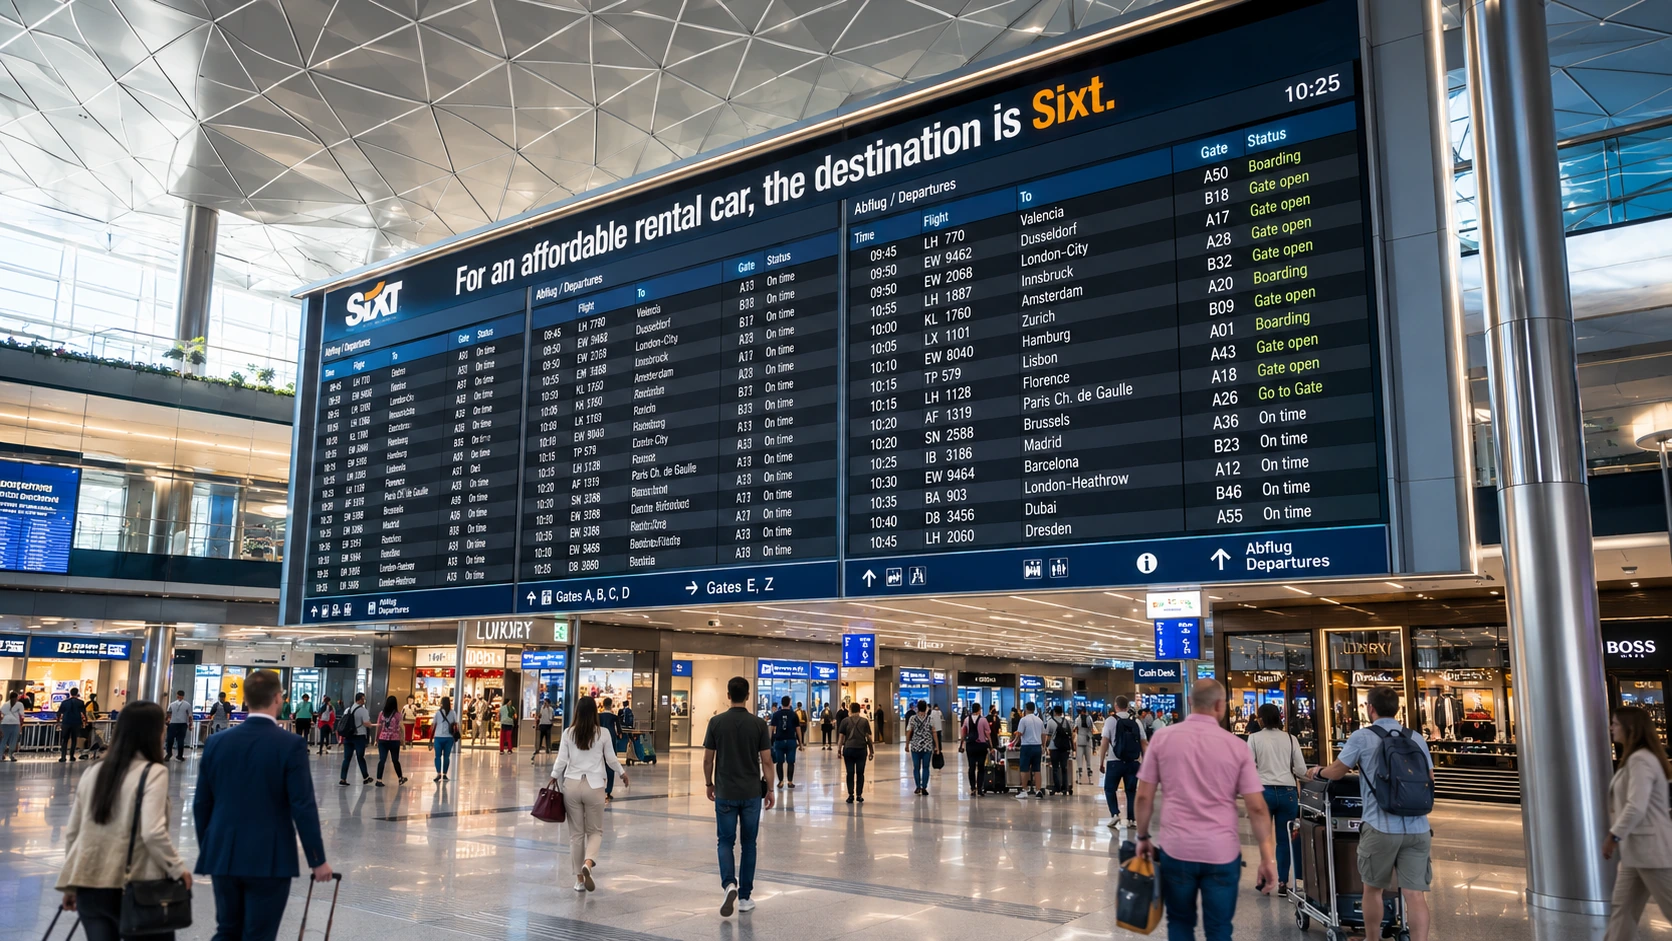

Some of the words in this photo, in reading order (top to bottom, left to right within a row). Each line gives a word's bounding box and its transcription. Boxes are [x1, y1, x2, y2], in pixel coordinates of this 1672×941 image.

[1285, 73, 1340, 102] 10:25
[455, 264, 486, 296] For
[490, 258, 515, 285] an
[520, 220, 627, 277] affordable
[634, 193, 702, 244] rental
[710, 186, 754, 222] car,
[762, 170, 805, 206] the
[814, 119, 981, 192] destination
[993, 103, 1021, 141] is
[1032, 75, 1115, 129] Sixt.
[854, 231, 875, 243] Time
[923, 211, 949, 227] Flight
[1019, 190, 1032, 203] To
[1200, 143, 1228, 159] Gate
[1247, 129, 1287, 147] Status
[854, 198, 887, 215] Abflug
[898, 179, 956, 203] Departures
[870, 245, 897, 262] 09:45
[924, 235, 938, 249] LH
[945, 229, 965, 244] 770
[1020, 206, 1064, 226] Valencia
[1203, 165, 1228, 184] A50
[1248, 151, 1301, 172] Boarding
[870, 263, 897, 280] 09:50
[924, 253, 941, 268] EW
[945, 246, 972, 264] 9462
[1020, 221, 1077, 247] Dusseldorf
[1205, 187, 1229, 205] B18
[1249, 179, 1276, 194] Gate
[1279, 172, 1309, 189] open
[870, 282, 897, 299] 09:50
[924, 273, 941, 288] EW
[945, 266, 973, 283] 2068
[1021, 242, 1088, 267] London-City
[1205, 209, 1229, 227] A17
[1250, 201, 1277, 217] Gate
[1280, 195, 1310, 211] open
[563, 274, 603, 293] Departures
[637, 288, 646, 298] To
[738, 261, 755, 273] Gate
[766, 252, 791, 266] Status
[766, 275, 777, 286] On
[779, 272, 795, 284] time
[870, 301, 897, 317] 10:55
[924, 292, 938, 307] LH
[946, 286, 972, 302] 1887
[1021, 265, 1073, 287] Innsbruck
[1206, 231, 1231, 249] A28
[1251, 224, 1278, 239] Gate
[1281, 217, 1311, 235] open
[871, 320, 897, 336] 10:00
[924, 313, 938, 326] KL
[946, 306, 971, 322] 1760
[1021, 286, 1083, 307] Amsterdam
[1207, 254, 1232, 271] B32
[1252, 247, 1280, 261] Gate
[1283, 240, 1313, 257] open
[345, 280, 403, 327] SIXT
[870, 339, 897, 355] 10:05
[924, 331, 938, 346] LX
[946, 326, 969, 341] 1101
[1022, 309, 1055, 327] Zurich
[1207, 276, 1233, 293] A20
[1253, 265, 1308, 284] Boarding
[870, 358, 897, 374] 10:10
[924, 350, 942, 365] EW
[946, 345, 974, 361] 8040
[1022, 330, 1070, 347] Hamburg
[1209, 298, 1234, 316] B09
[1254, 292, 1281, 307] Gate
[1285, 287, 1316, 304] open
[870, 377, 897, 393] 10:15
[924, 371, 938, 384] TP
[941, 367, 961, 382] 579
[1022, 353, 1058, 368] Lisbon
[1209, 321, 1234, 339] A01
[1255, 311, 1310, 330] Boarding
[870, 397, 897, 412] 10:15
[925, 390, 939, 404] LH
[945, 385, 971, 400] 1128
[1023, 373, 1070, 389] Florence
[1210, 344, 1236, 361] A43
[1256, 339, 1284, 354] Gate
[1288, 335, 1318, 351] open
[870, 416, 897, 431] 10:20
[924, 410, 939, 424] AF
[946, 406, 972, 420] 1319
[1023, 395, 1050, 410] Paris
[1054, 391, 1073, 405] Ch.
[1077, 388, 1092, 402] de
[1096, 382, 1133, 399] Gaulle
[1211, 367, 1237, 384] A18
[1257, 362, 1285, 377] Gate
[1289, 358, 1320, 374] open
[764, 399, 776, 410] On
[777, 397, 794, 409] time
[870, 436, 897, 450] 10:20
[925, 430, 940, 444] SN
[946, 426, 974, 441] 2588
[1024, 413, 1070, 431] Brussels
[1212, 390, 1238, 407] A26
[1258, 386, 1275, 400] Go
[1278, 385, 1291, 397] to
[1294, 381, 1323, 395] Gate
[870, 455, 897, 470] 10:25
[925, 450, 936, 464] IB
[946, 446, 972, 461] 3186
[1024, 434, 1062, 452] Madrid
[1213, 413, 1239, 430] A36
[1259, 410, 1276, 424] On
[1279, 408, 1306, 422] time
[870, 475, 897, 489] 10:30
[925, 470, 943, 484] EW
[946, 466, 975, 481] 9464
[1024, 456, 1079, 473] Barcelona
[1214, 437, 1240, 453] B23
[1260, 434, 1277, 448] On
[1280, 432, 1308, 446] time
[870, 495, 897, 509] 10:35
[925, 491, 941, 504] BA
[946, 488, 967, 502] 903
[1024, 473, 1129, 494] London-Heathrow
[1215, 460, 1240, 476] A12
[1261, 457, 1278, 471] On
[1281, 456, 1309, 470] time
[870, 515, 897, 529] 10:40
[925, 511, 940, 524] D8
[947, 508, 974, 523] 3456
[1025, 500, 1057, 516] Dubai
[1216, 484, 1242, 500] B46
[1262, 482, 1279, 496] On
[1282, 480, 1310, 494] time
[762, 545, 774, 556] On
[775, 544, 792, 555] time
[870, 534, 897, 548] 10:45
[925, 531, 940, 545] LH
[947, 529, 974, 543] 2060
[1025, 521, 1072, 537] Dresden
[1216, 508, 1243, 524] A55
[1263, 506, 1280, 520] On
[1284, 505, 1311, 519] time
[1246, 541, 1293, 556] Abflug
[706, 580, 742, 595] Gates
[747, 578, 759, 594] E,
[764, 576, 774, 591] Z
[1246, 555, 1330, 572] Departures
[556, 590, 583, 603] Gates
[584, 589, 595, 603] A,
[596, 588, 607, 602] B,
[608, 586, 619, 601] C,
[622, 586, 630, 599] D
[1606, 640, 1656, 653] BOSS
